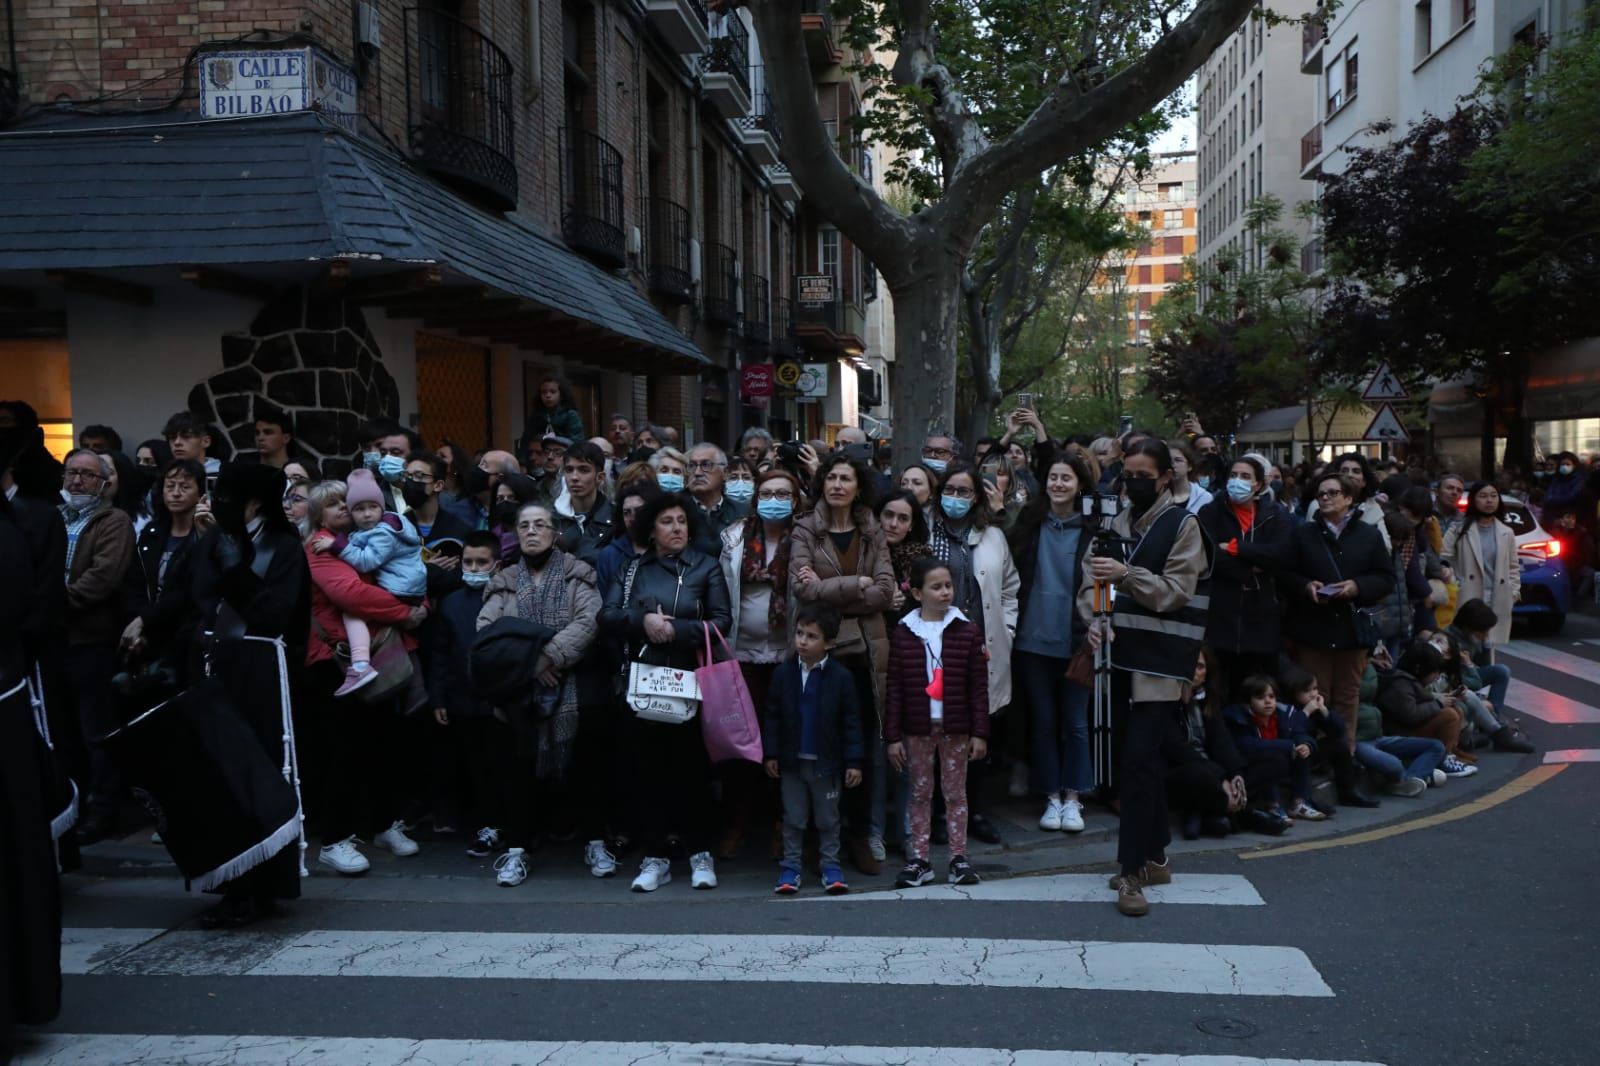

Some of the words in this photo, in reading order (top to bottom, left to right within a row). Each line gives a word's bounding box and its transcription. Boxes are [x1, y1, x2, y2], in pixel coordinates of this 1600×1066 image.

[238, 57, 300, 78] CALLE
[255, 79, 271, 89] DE
[215, 94, 292, 115] BILBAO
